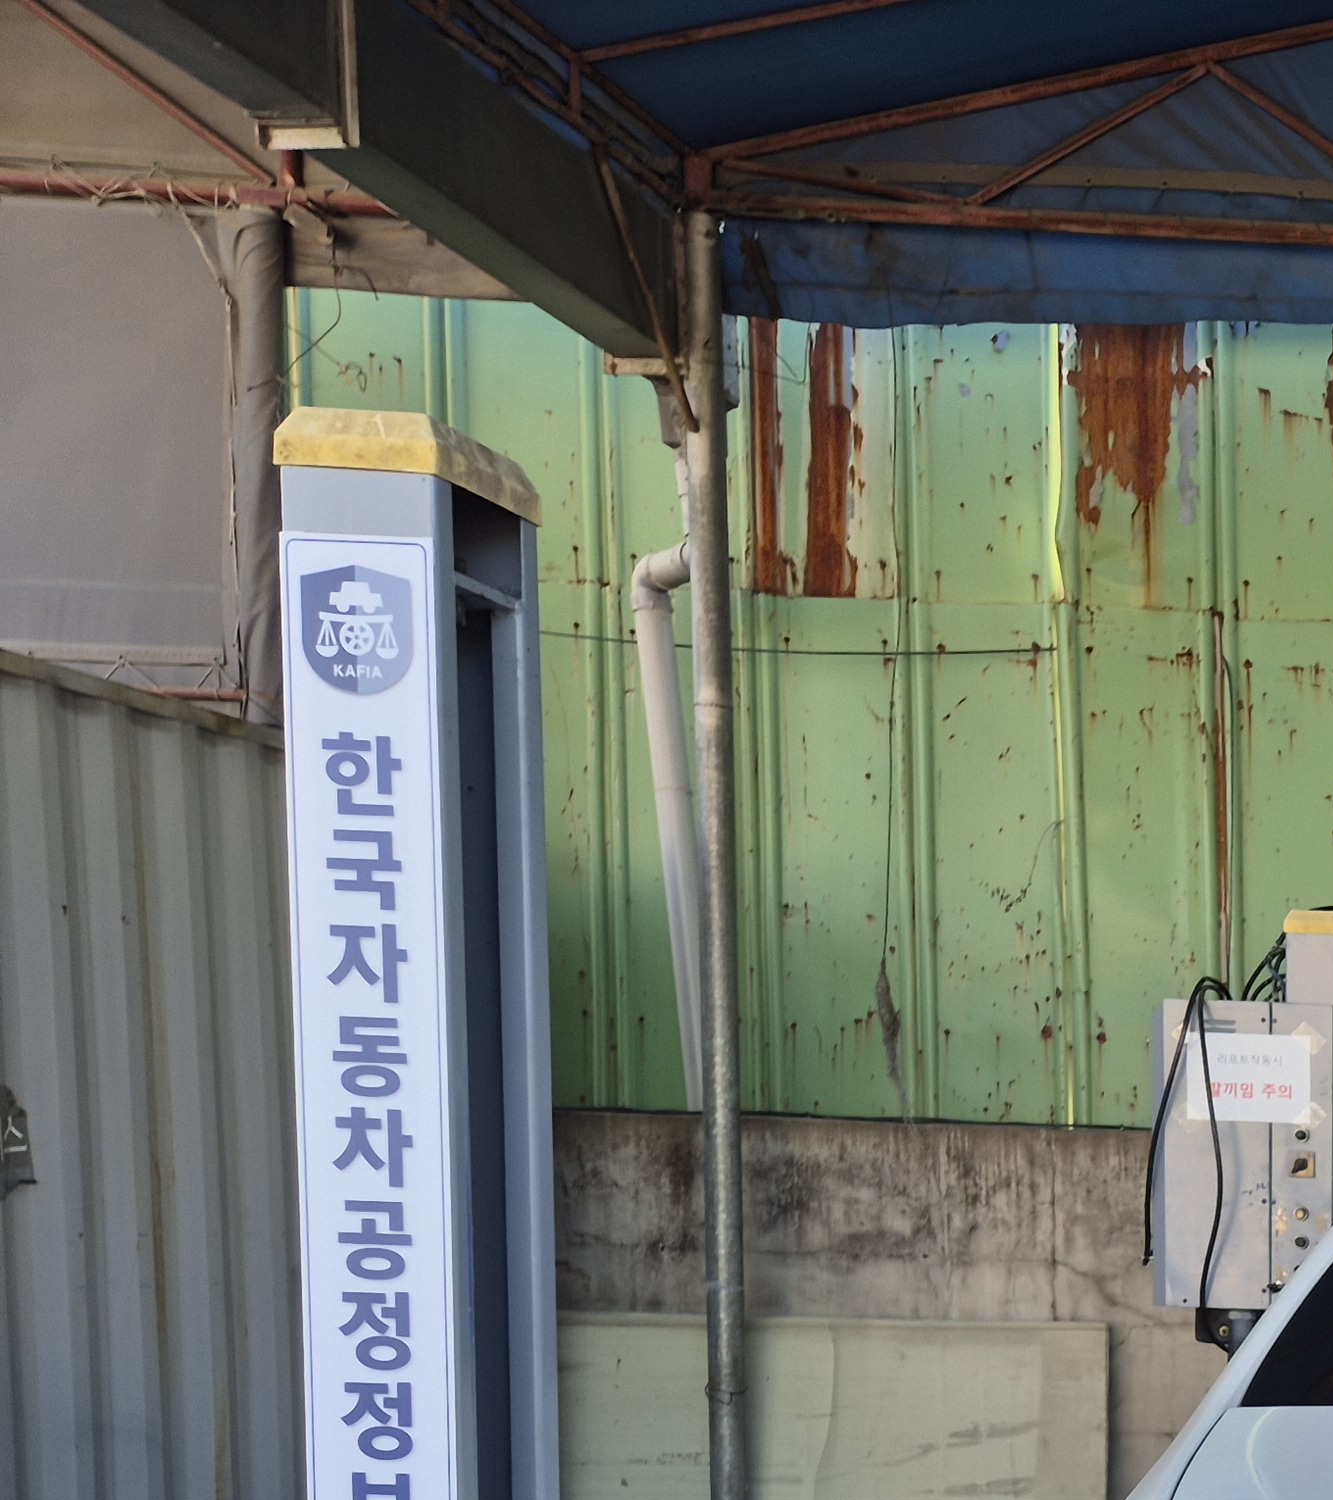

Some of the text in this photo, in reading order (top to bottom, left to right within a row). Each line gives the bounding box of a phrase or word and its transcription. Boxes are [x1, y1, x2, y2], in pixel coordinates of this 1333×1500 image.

[332, 663, 383, 680] KAFIA
[1217, 1053, 1283, 1067] 리프트작동시
[1262, 1083, 1293, 1100] 주의
[1, 1115, 28, 1155] 스
